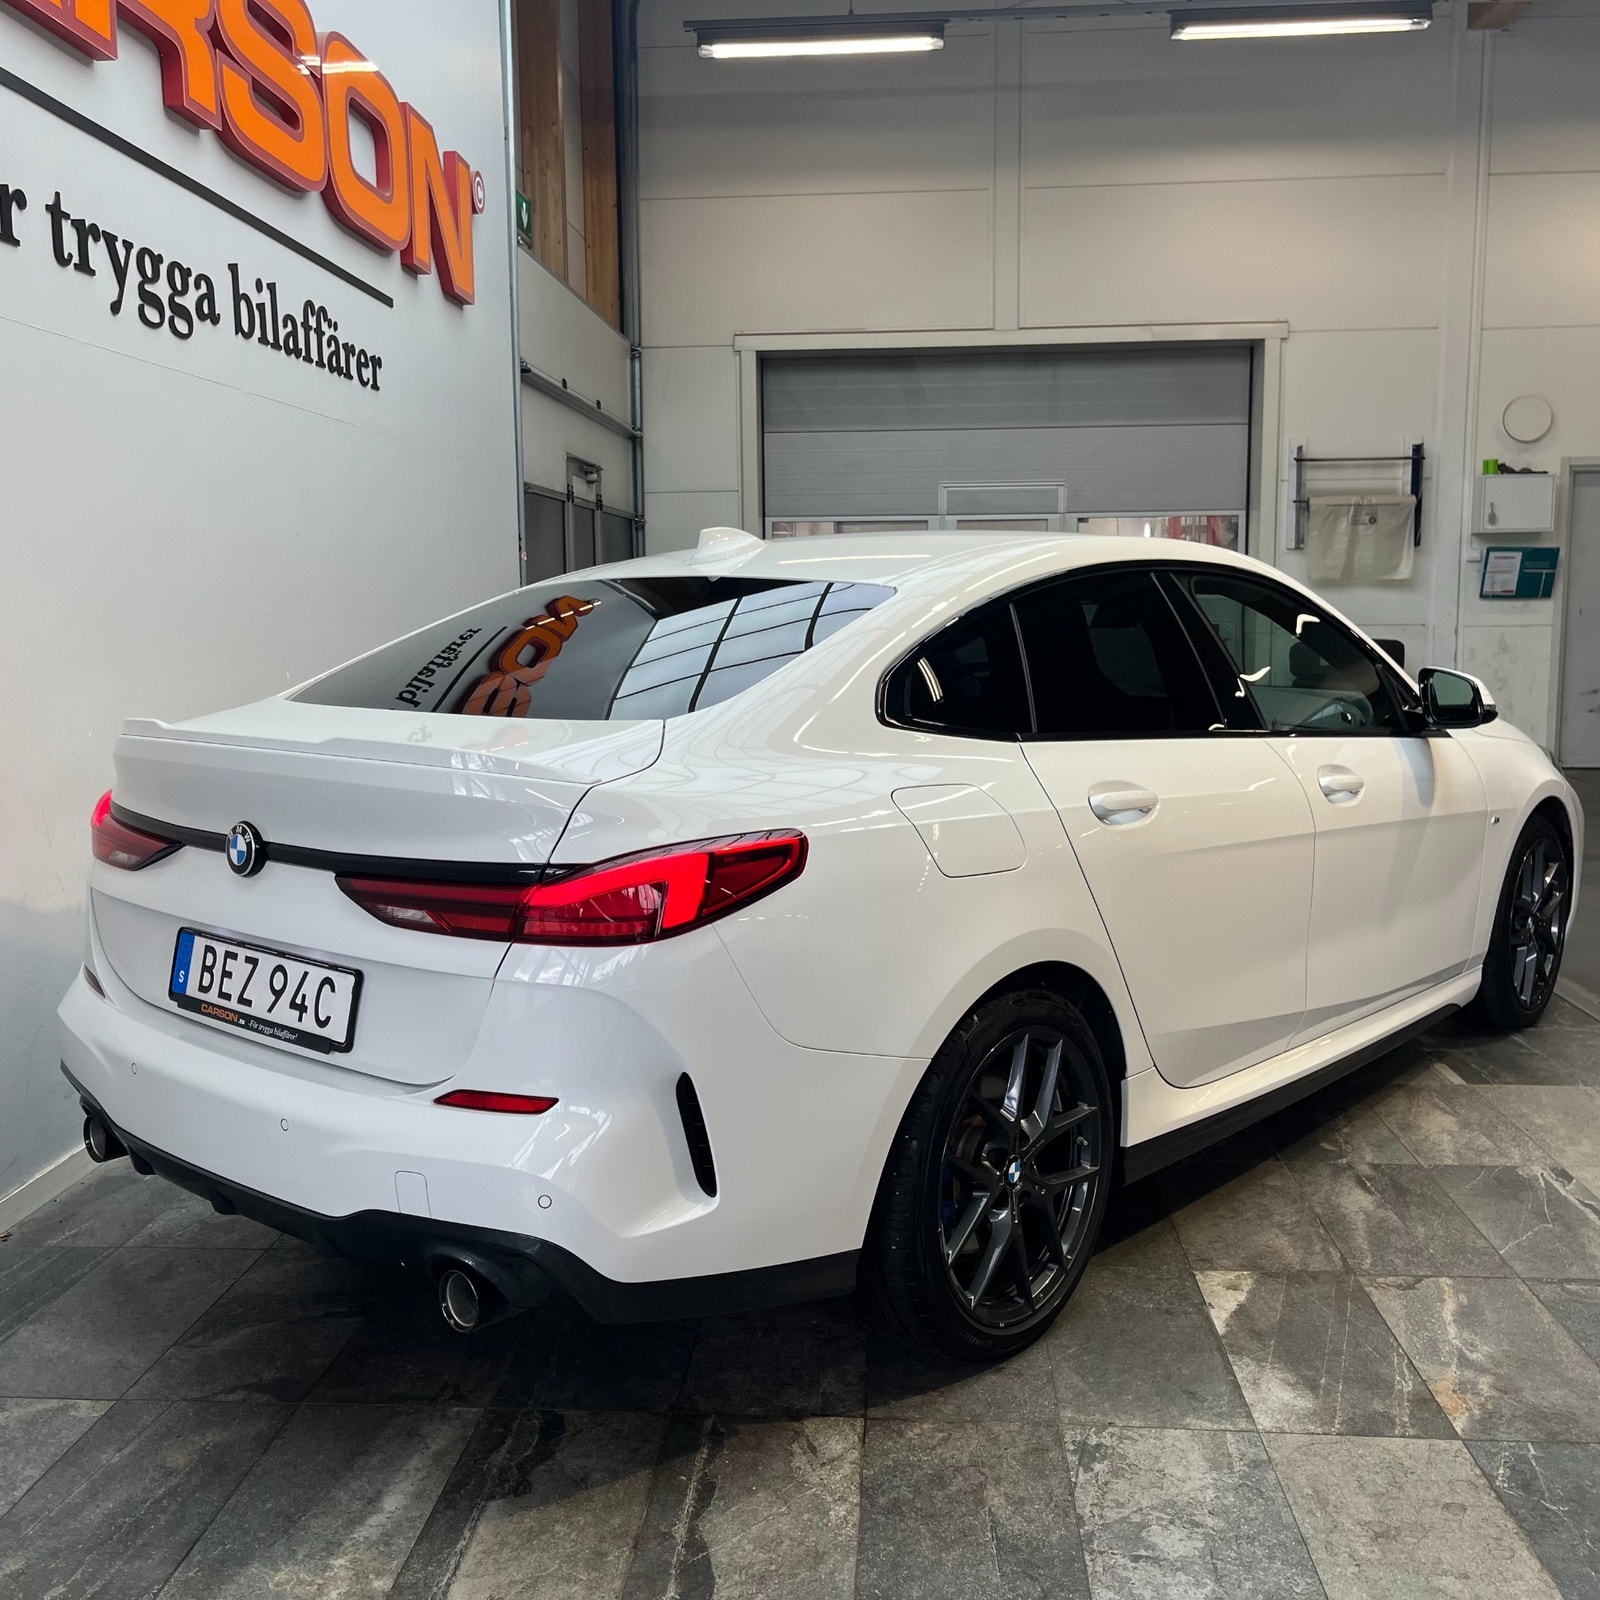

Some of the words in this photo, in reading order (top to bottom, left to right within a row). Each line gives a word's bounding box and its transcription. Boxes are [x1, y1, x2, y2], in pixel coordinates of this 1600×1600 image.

[46, 191, 220, 340] trygga
[228, 263, 382, 391] bilaffärer
[178, 970, 185, 983] S
[198, 944, 259, 1007] BEZ
[267, 964, 336, 1028] 94C
